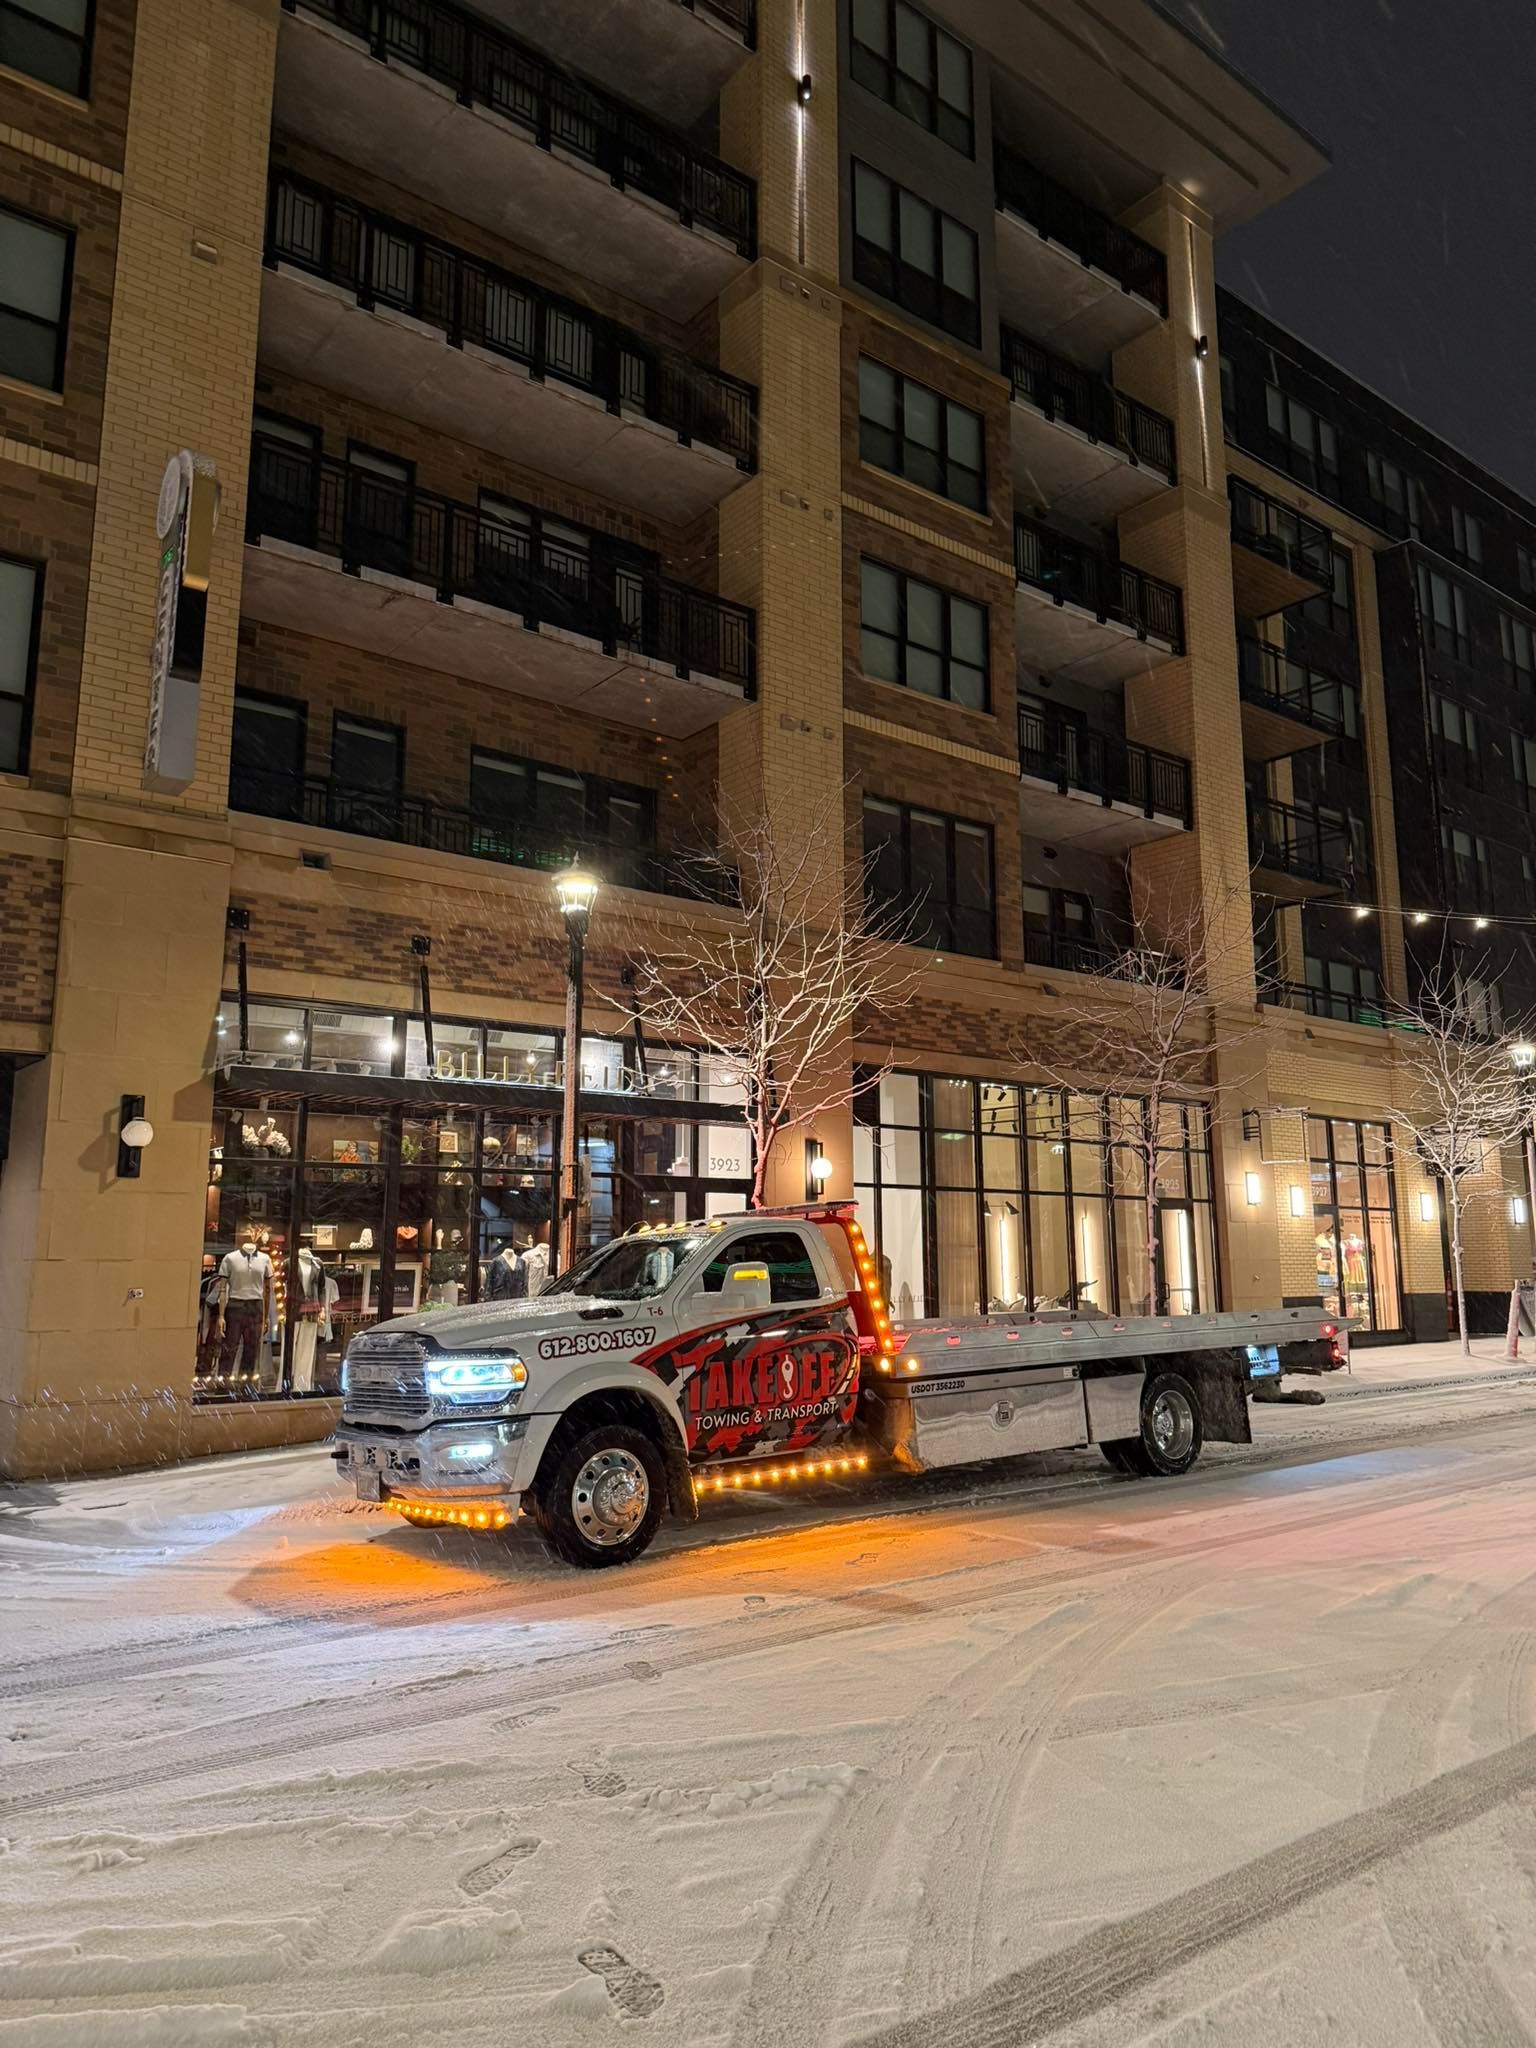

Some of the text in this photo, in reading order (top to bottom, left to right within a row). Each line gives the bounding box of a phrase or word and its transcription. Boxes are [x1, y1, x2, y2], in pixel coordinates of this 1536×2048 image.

[436, 1050, 542, 1084] BILLY
[710, 1157, 740, 1172] 3923
[647, 1307, 664, 1316] T-6
[538, 1326, 656, 1360] 612.800.1607
[671, 1339, 835, 1411] TAKEOFF
[911, 1383, 936, 1394] USDOT
[696, 1401, 838, 1430] TOWING & TRANSPORT
